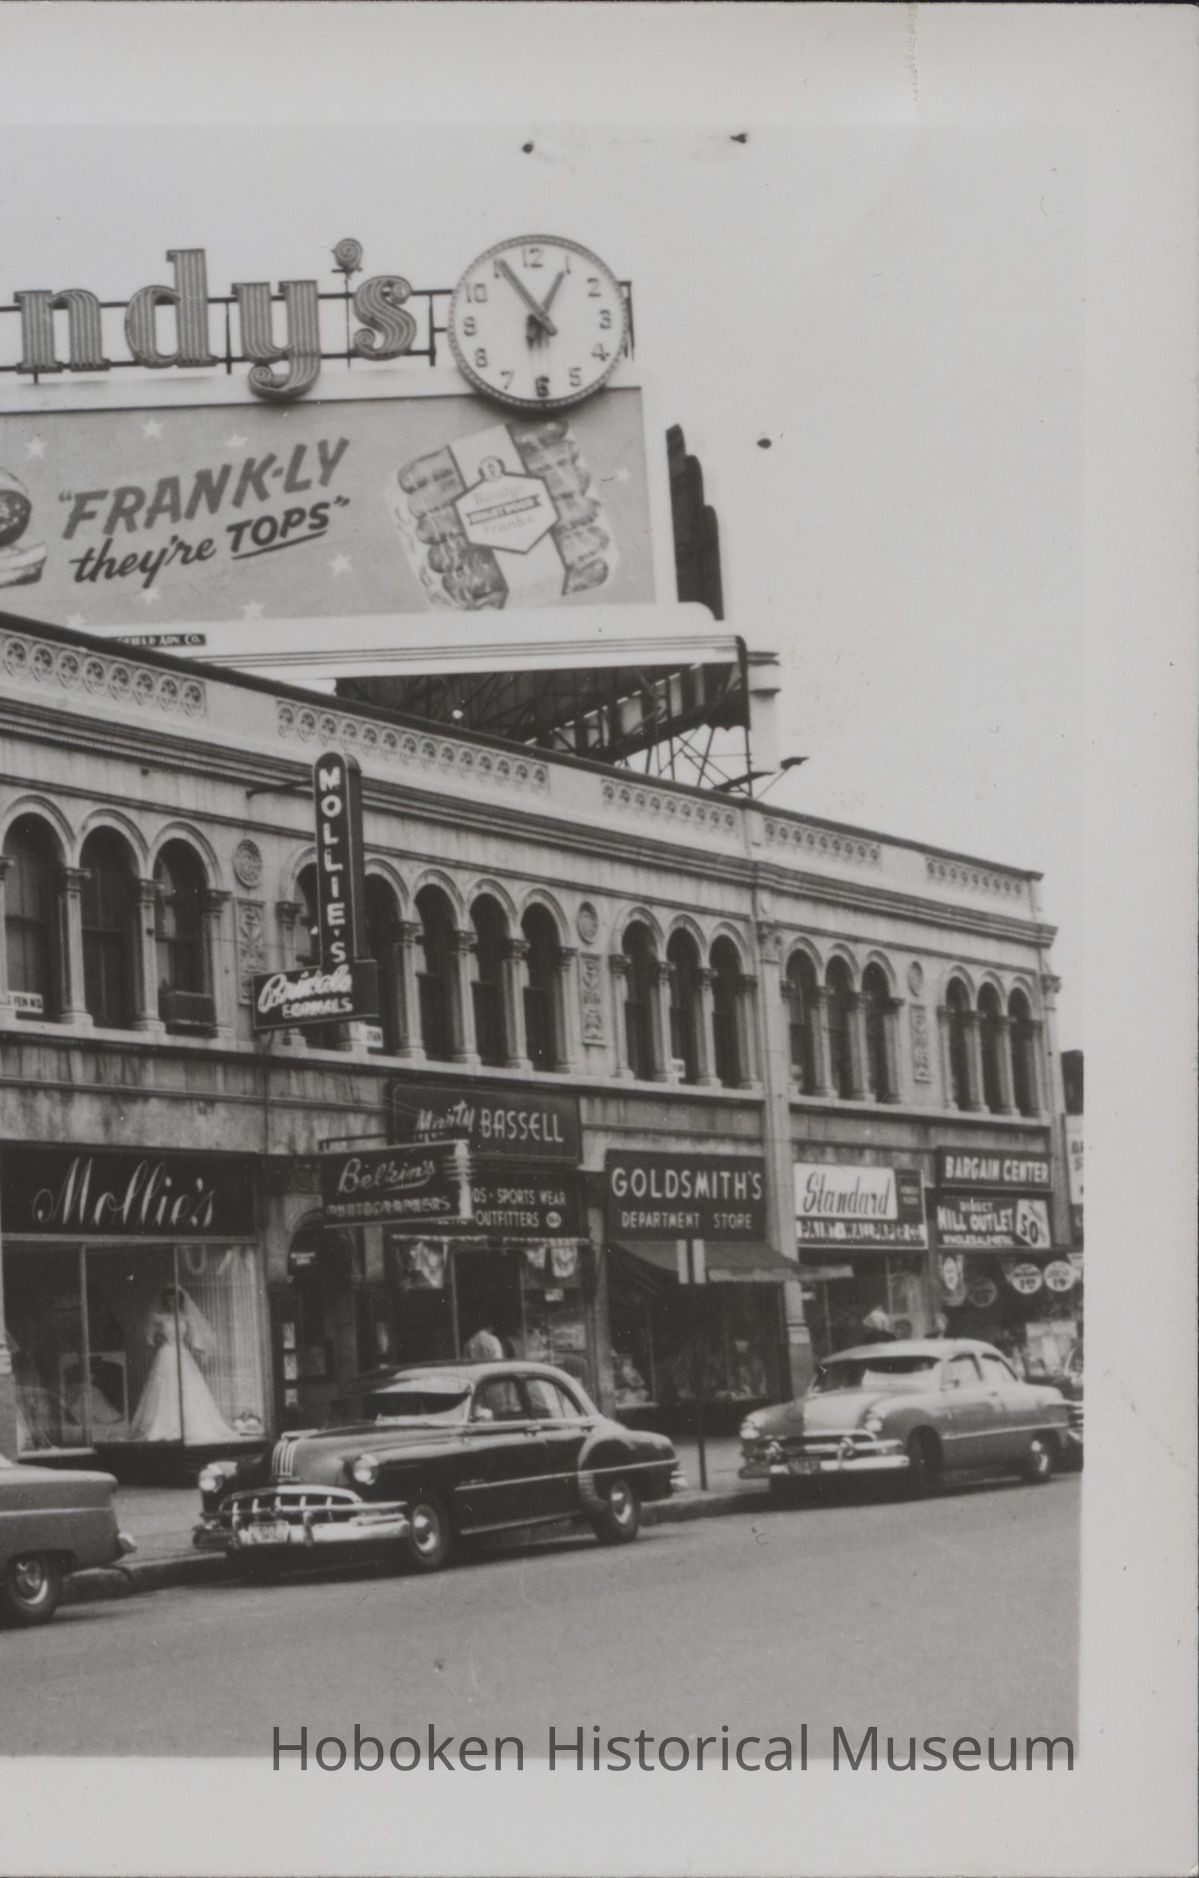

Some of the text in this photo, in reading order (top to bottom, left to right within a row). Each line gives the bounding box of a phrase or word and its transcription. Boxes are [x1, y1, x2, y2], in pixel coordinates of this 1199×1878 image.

[522, 248, 543, 267] 12
[465, 283, 488, 303] 10
[587, 277, 601, 298] 2
[599, 309, 612, 330] 3
[500, 369, 514, 390] 7
[569, 367, 582, 387] 5
[69, 534, 217, 589] they're
[319, 766, 346, 963] MOLLIE'S
[480, 1108, 564, 1143] BASSELL
[945, 1156, 1049, 1183] BARGAIN CENTER
[32, 1156, 216, 1228] Mollie's
[611, 1167, 763, 1200] GOLDSMITH'S
[802, 1172, 891, 1215] Standard
[496, 1188, 535, 1206] SPORTS
[539, 1190, 567, 1206] WEAR
[474, 1210, 540, 1228] OUTFITTERS
[622, 1211, 753, 1230] DEPARTMENT STORE
[970, 1208, 1013, 1232] OUTLET
